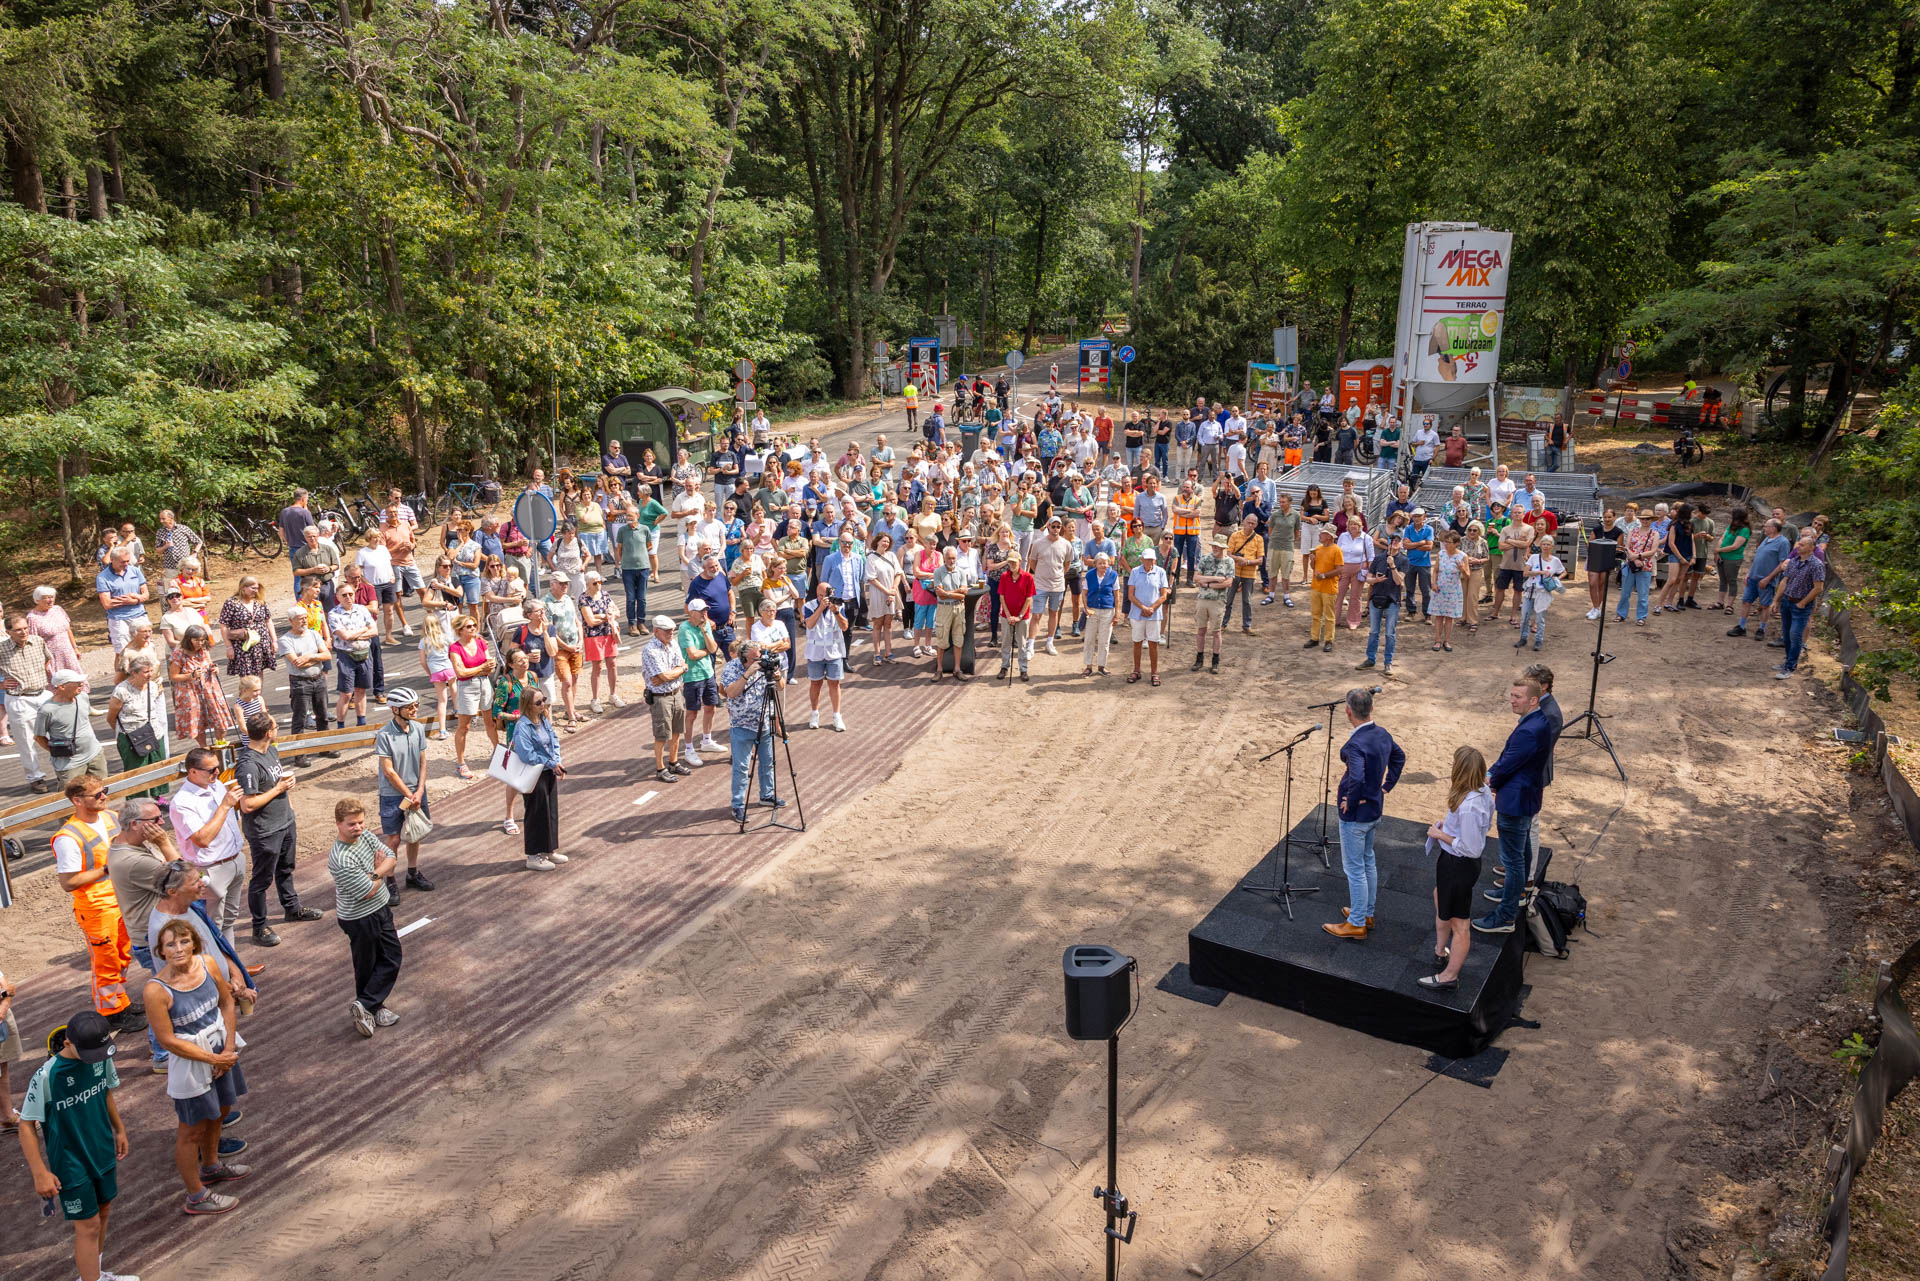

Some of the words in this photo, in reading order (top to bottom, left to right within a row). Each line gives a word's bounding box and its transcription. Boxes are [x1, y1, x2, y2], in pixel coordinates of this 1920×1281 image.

[1438, 250, 1502, 268] MEGA
[1446, 268, 1491, 286] MIX
[1456, 301, 1487, 309] TERRAQ
[56, 1078, 107, 1111] nexperia
